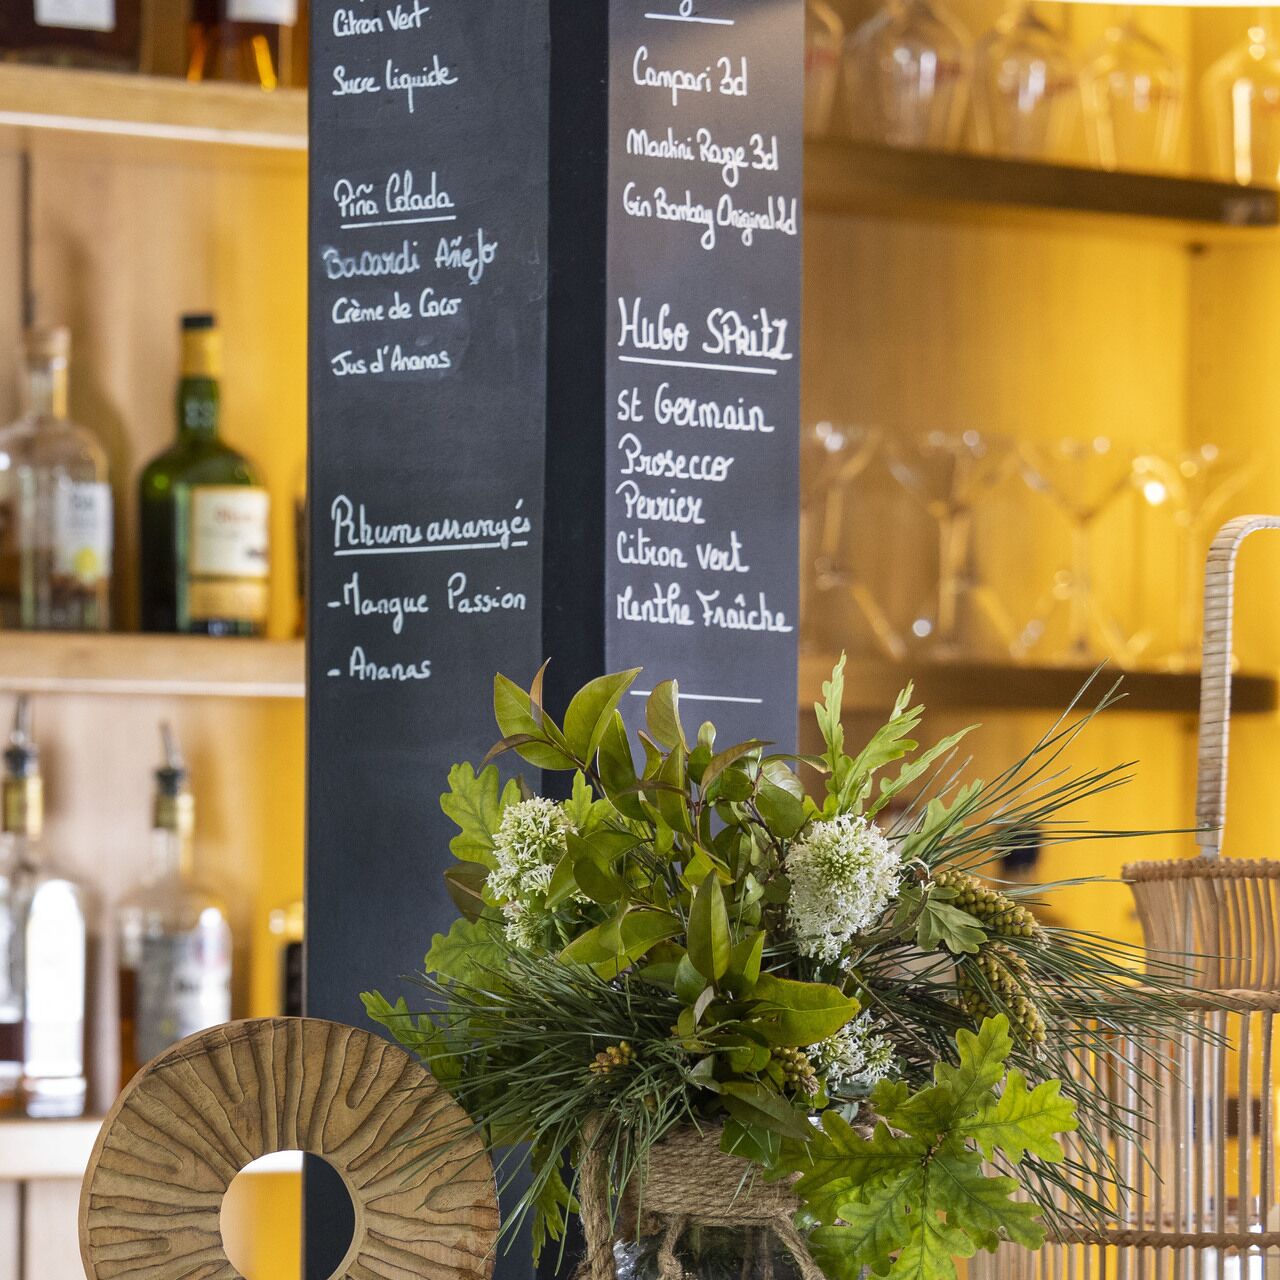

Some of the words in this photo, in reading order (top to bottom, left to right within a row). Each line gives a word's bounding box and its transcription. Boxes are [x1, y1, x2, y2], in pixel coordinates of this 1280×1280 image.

[333, 9, 383, 37] Citron
[387, 0, 430, 31] Vert
[332, 65, 381, 95] Sucre
[633, 45, 711, 106] Campari
[717, 57, 747, 96] 3d
[626, 127, 694, 160] Martini
[697, 128, 748, 187] Rouge
[749, 134, 779, 171] 3d
[333, 179, 379, 217] Piña
[385, 169, 455, 212] Colada
[623, 182, 652, 217] Gin
[653, 187, 715, 250] Bombay
[322, 240, 420, 279] Bacardi
[332, 297, 384, 324] Crème
[388, 291, 413, 319] de
[419, 287, 462, 317] Coco
[331, 350, 367, 375] Jus
[617, 387, 644, 422] St
[654, 382, 775, 433] Germain
[618, 432, 735, 481] Prosecco
[615, 480, 706, 524] Perrier
[616, 528, 688, 568] Citron
[447, 571, 527, 614] Passion
[616, 582, 695, 626] Menthe
[695, 589, 794, 633] Fraîche
[349, 645, 432, 681] Ananas
